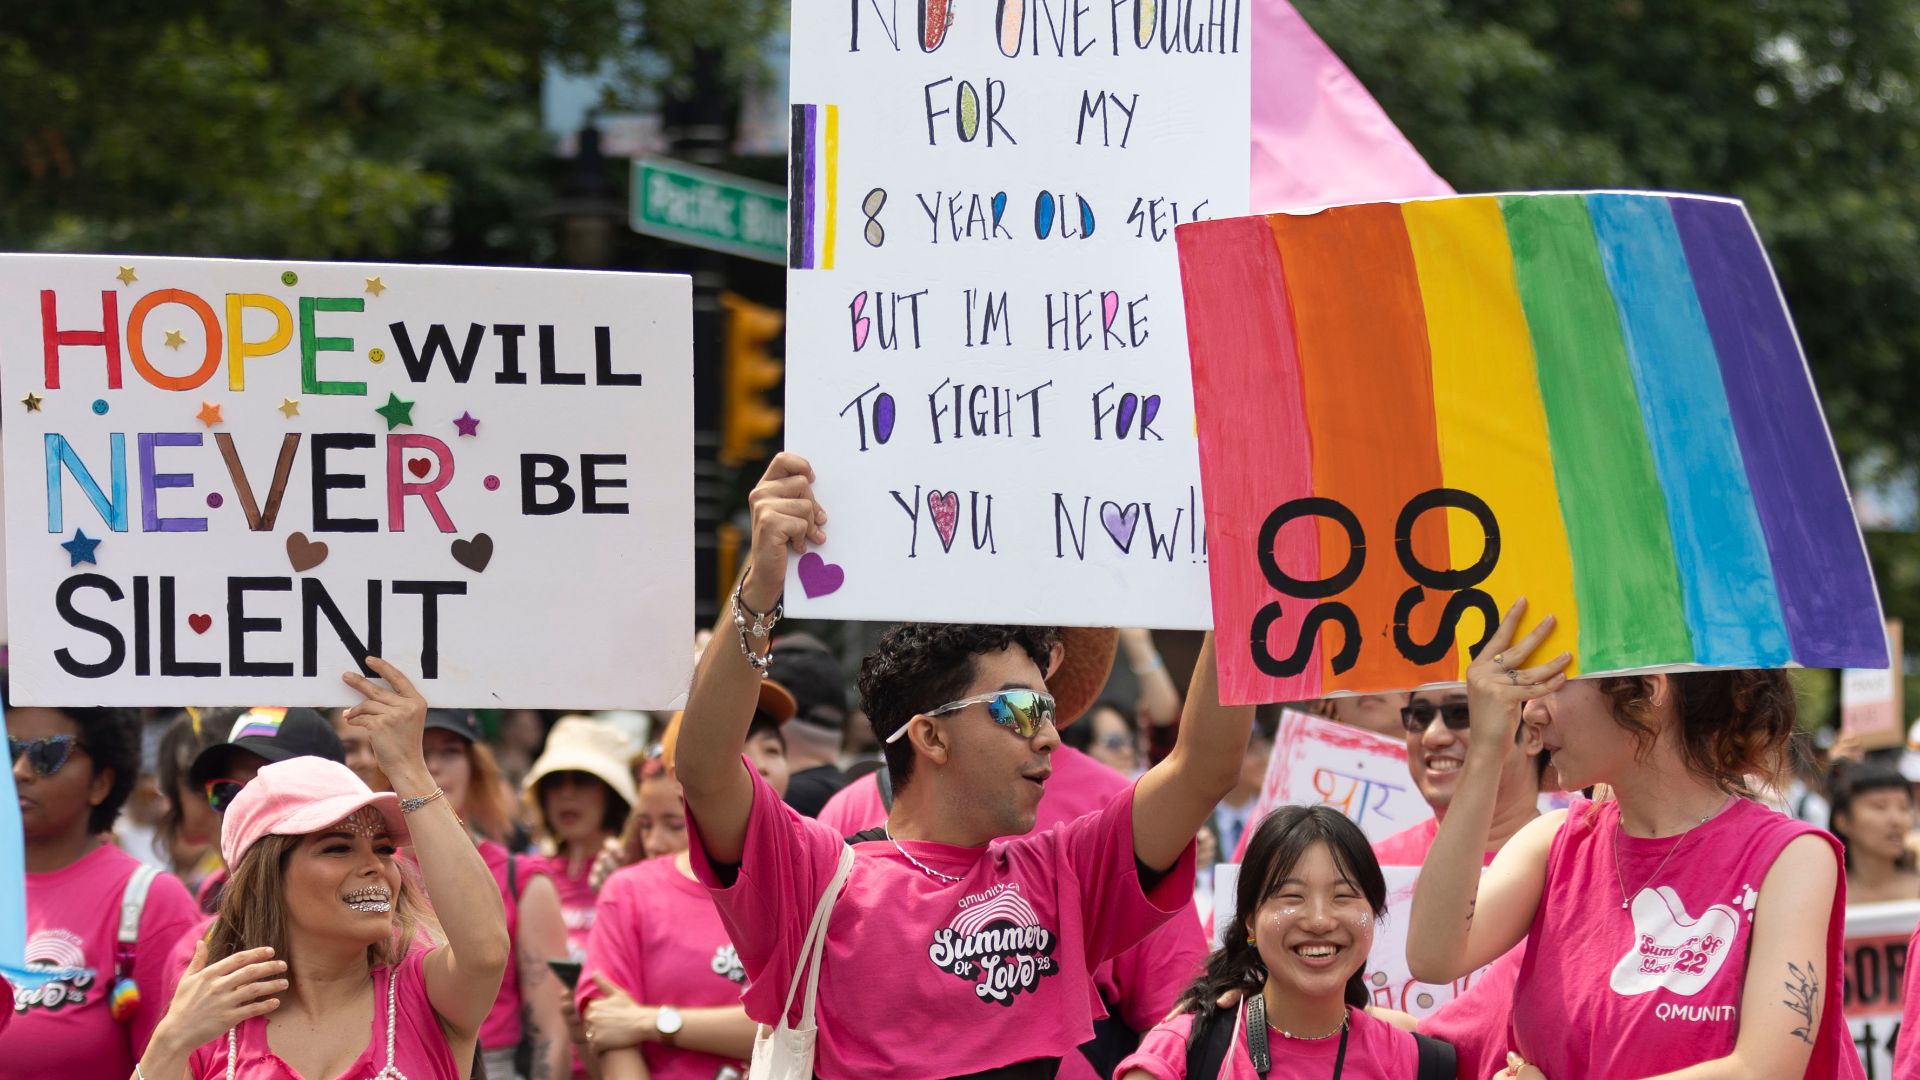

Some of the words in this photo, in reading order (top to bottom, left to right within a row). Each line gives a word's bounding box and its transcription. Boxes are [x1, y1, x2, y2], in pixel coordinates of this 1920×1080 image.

[849, 0, 954, 54] NO
[925, 75, 1017, 148] FOR
[1075, 90, 1139, 149] MY
[861, 187, 887, 248] 8
[916, 190, 1013, 243] YEAR
[1035, 189, 1096, 241] OLD
[39, 288, 368, 396] HOPE
[388, 320, 642, 387] WILL
[848, 288, 929, 353] BUT
[963, 287, 1013, 347] I'M
[1045, 289, 1150, 350] HERE
[839, 383, 896, 452] TO
[928, 377, 1053, 444] FIGHT
[1092, 382, 1164, 442] FOR
[44, 432, 459, 534] NEVER
[520, 453, 630, 516] BE
[53, 572, 468, 680] SILENT
[929, 925, 1049, 967] Summer
[954, 960, 973, 976] Of
[976, 953, 1035, 1001] Love
[1701, 935, 1723, 954] Of
